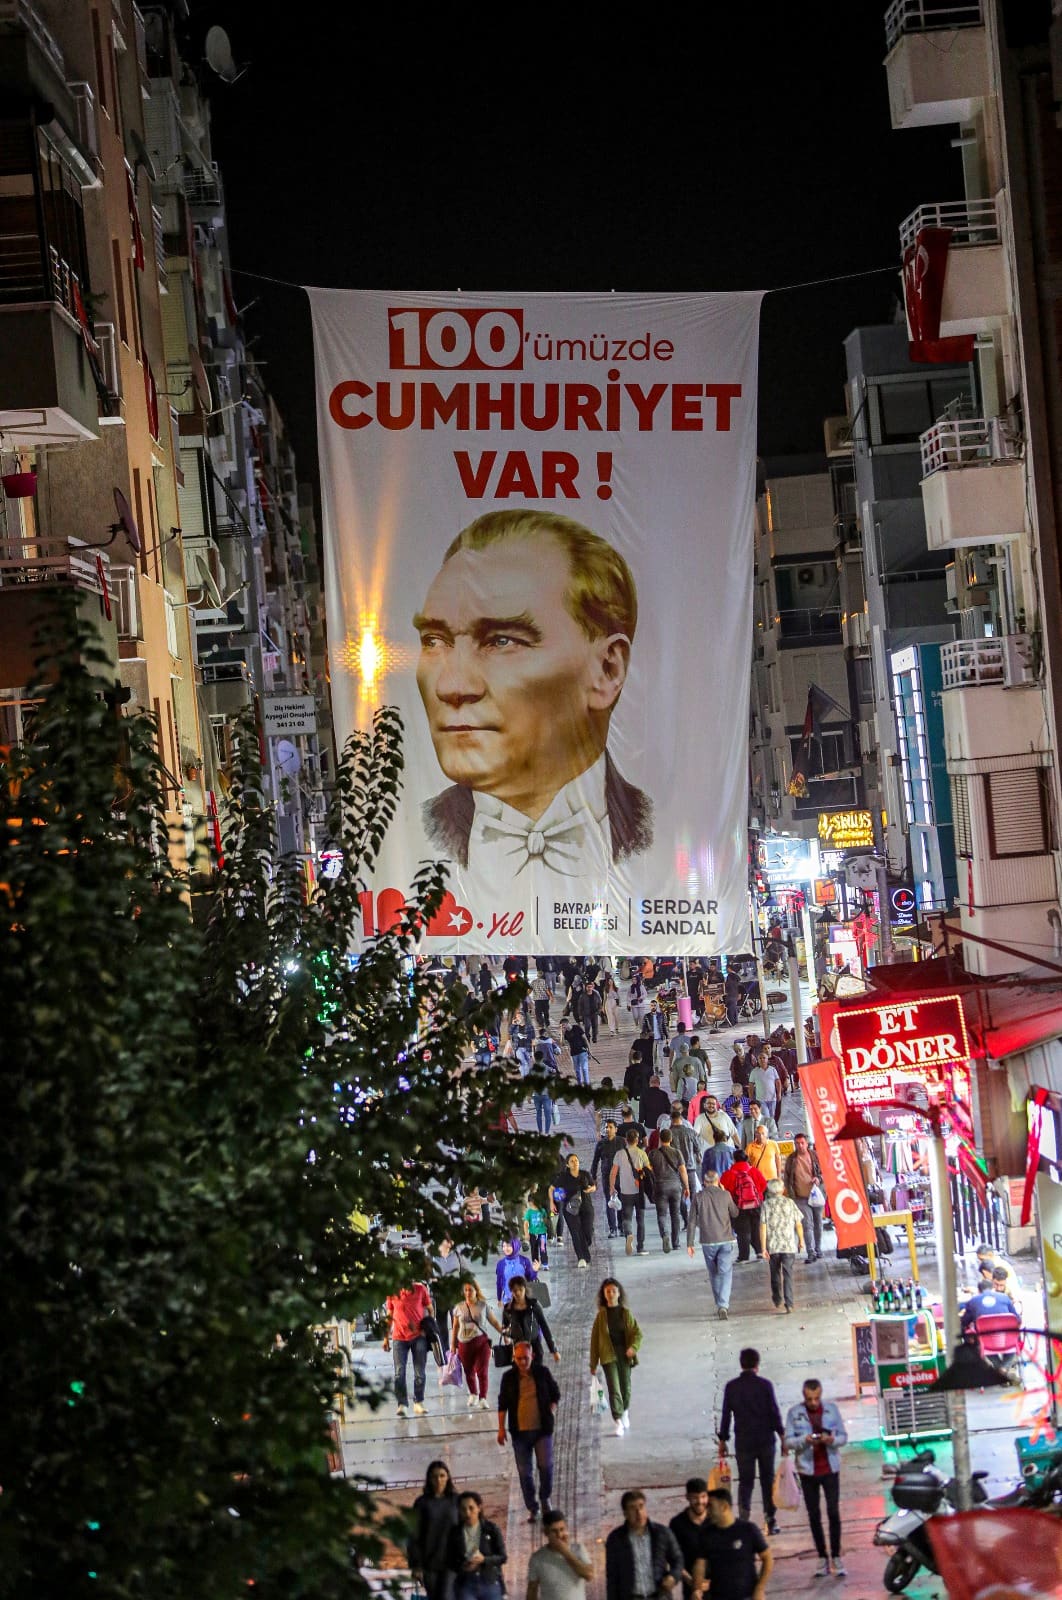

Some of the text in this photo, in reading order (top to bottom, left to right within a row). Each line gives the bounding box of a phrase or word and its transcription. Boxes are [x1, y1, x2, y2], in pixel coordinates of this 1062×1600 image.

[328, 368, 742, 432] CUMHURİYET
[453, 450, 581, 499] VAR
[265, 712, 289, 721] Ayşegül
[274, 705, 284, 713] Diş
[553, 902, 609, 915] BAYRAI
[641, 899, 719, 915] SERDAR
[641, 919, 716, 936] SANDAL
[876, 1005, 919, 1035] ET
[846, 1033, 961, 1073] DÖNER
